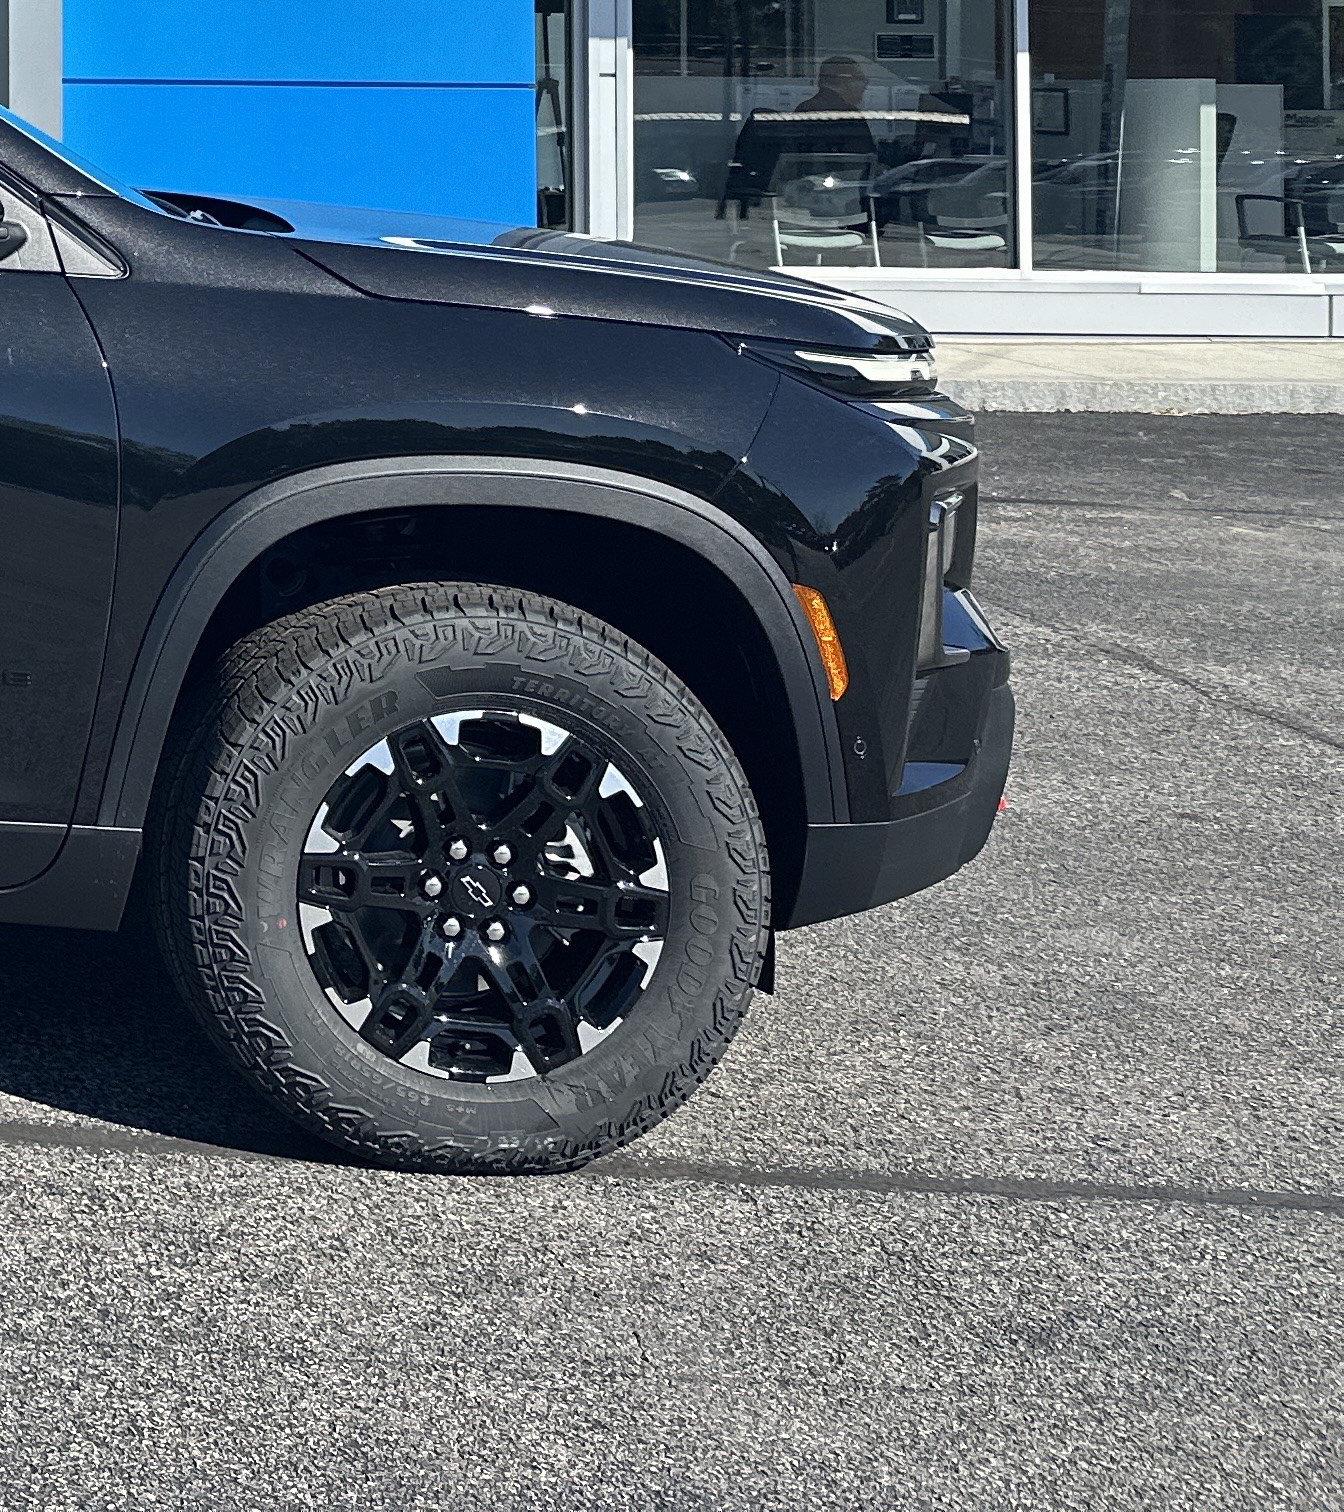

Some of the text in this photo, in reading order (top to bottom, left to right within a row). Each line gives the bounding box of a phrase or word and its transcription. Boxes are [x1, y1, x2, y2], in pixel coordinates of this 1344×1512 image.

[255, 687, 404, 917] WRANGLER
[511, 674, 635, 742] TERRITORY
[566, 871, 723, 1116] GOODYEAR
